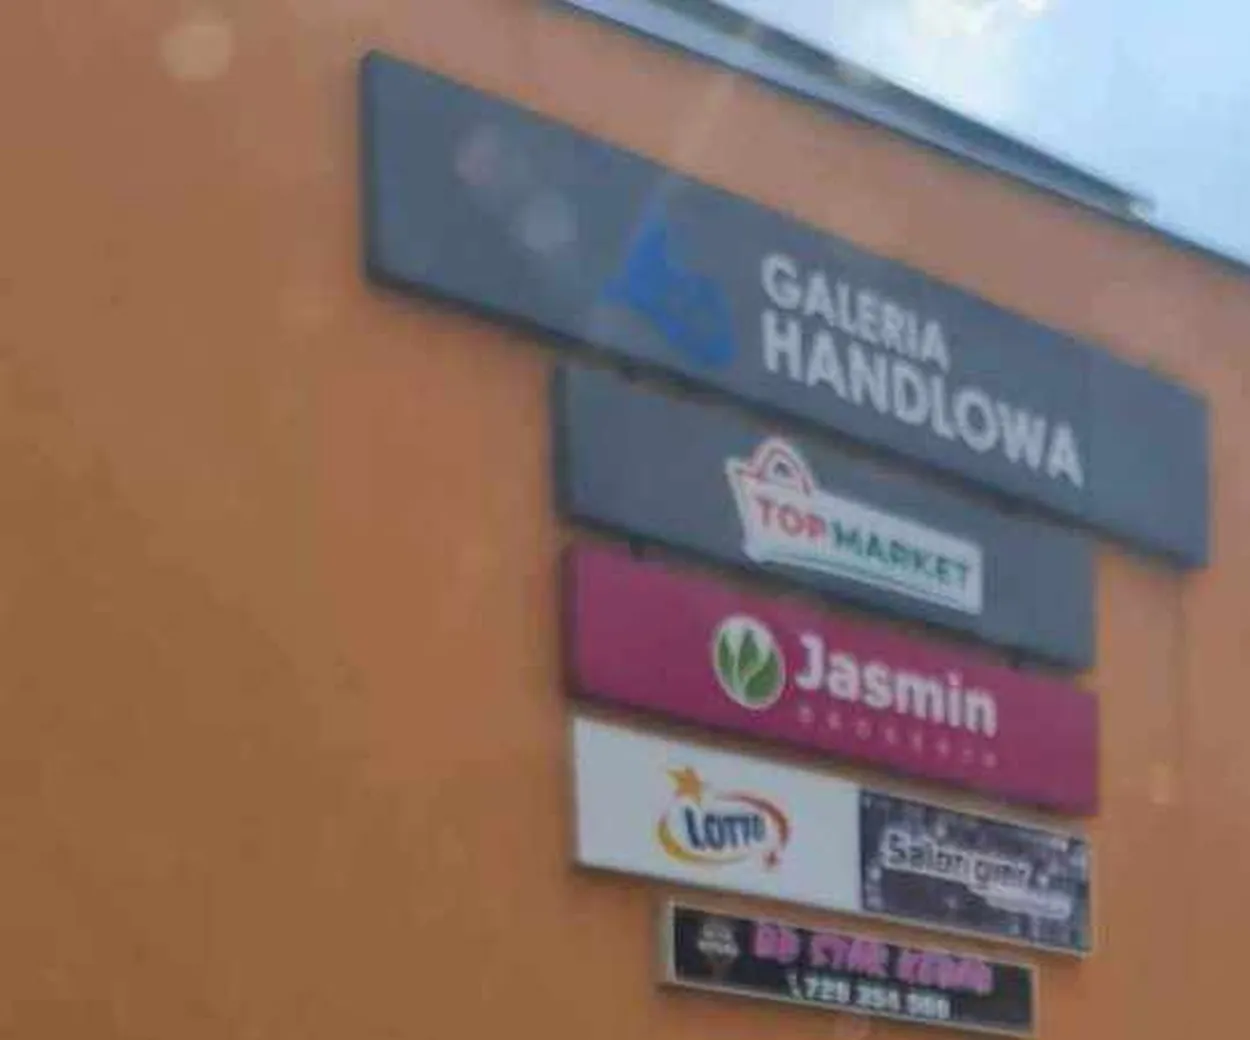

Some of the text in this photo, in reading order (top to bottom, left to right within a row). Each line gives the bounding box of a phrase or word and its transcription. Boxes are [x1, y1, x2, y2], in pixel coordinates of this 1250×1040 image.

[761, 253, 951, 371] GALERIA
[761, 311, 1084, 488] HANDLOWA
[795, 631, 998, 739] Jasmin
[683, 804, 766, 851] LOTTO
[885, 829, 966, 881] Salon
